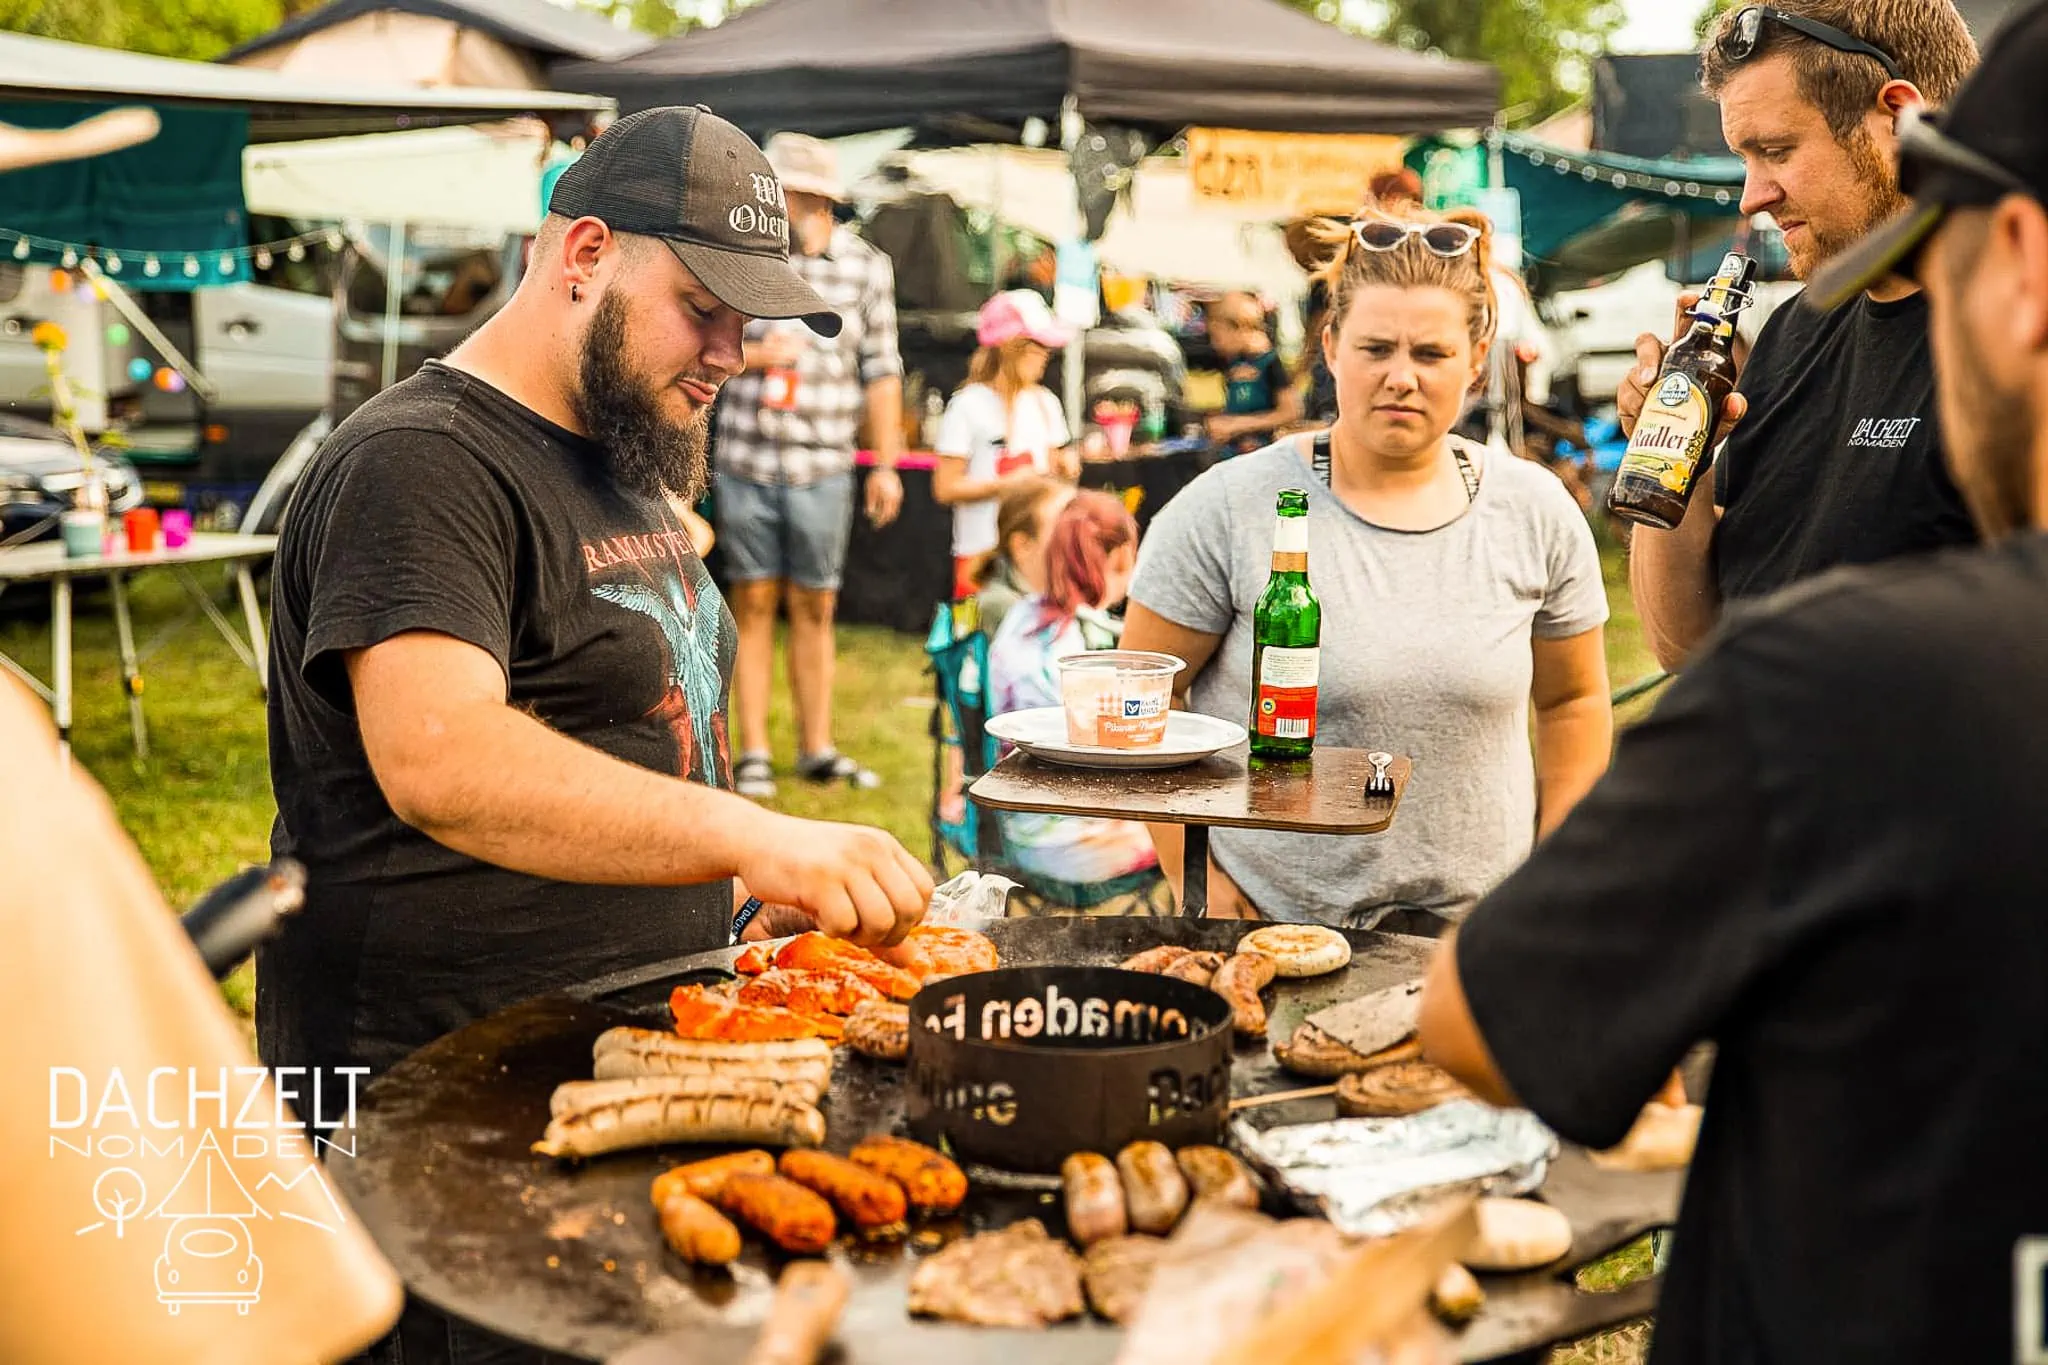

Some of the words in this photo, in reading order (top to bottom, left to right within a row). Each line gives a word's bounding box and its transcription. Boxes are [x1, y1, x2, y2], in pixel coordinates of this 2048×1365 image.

[1629, 425, 1689, 450] Radler
[1851, 416, 1921, 439] DACHZELT
[1847, 437, 1907, 448] NOMADEN
[582, 529, 694, 572] RAMMSTEI
